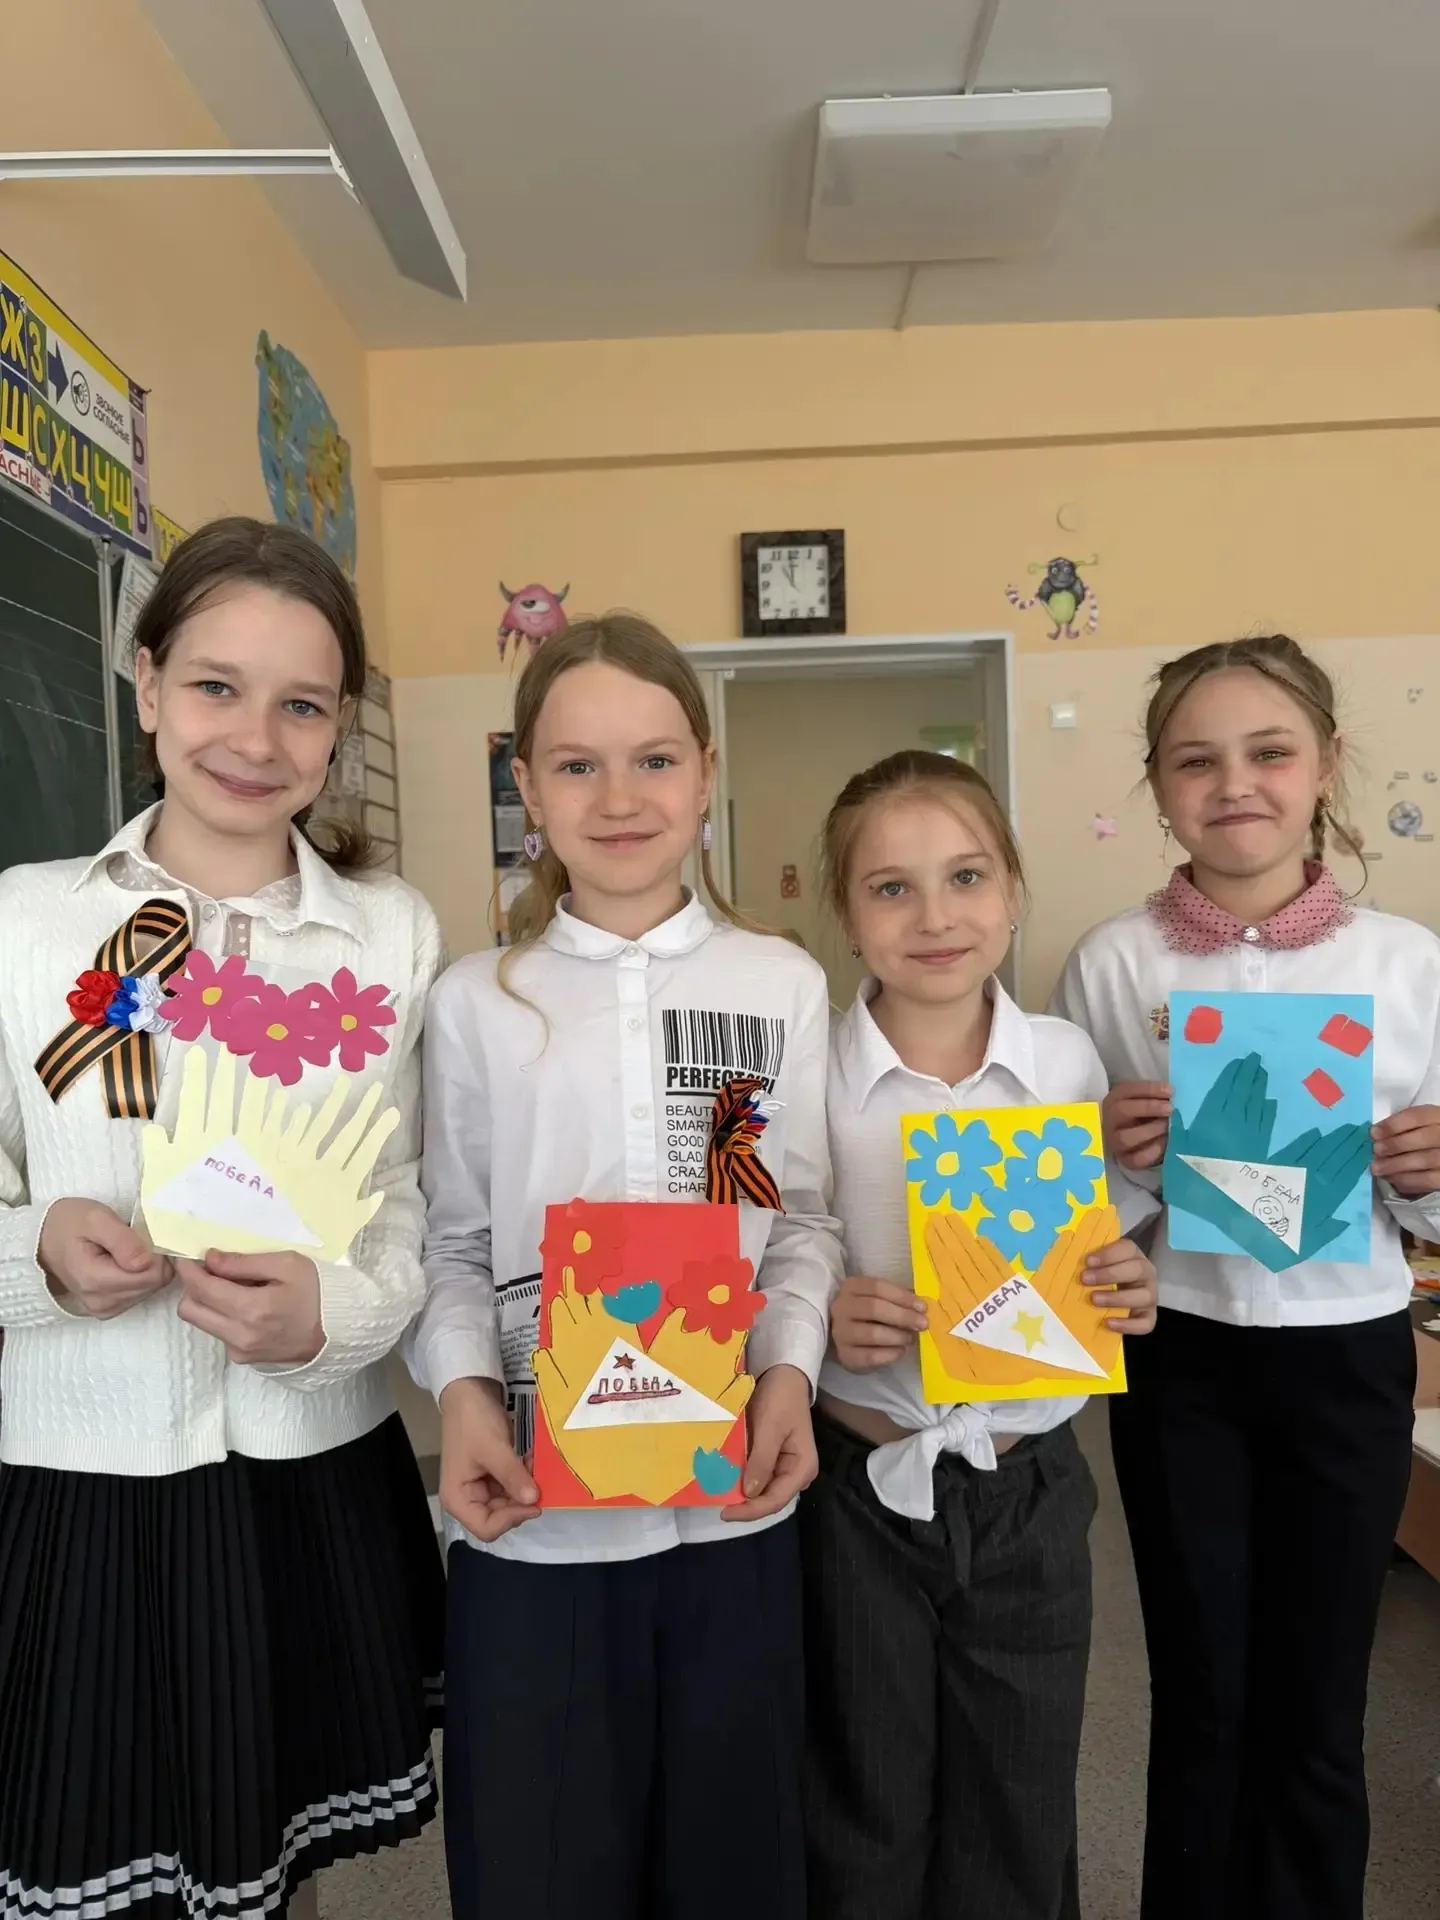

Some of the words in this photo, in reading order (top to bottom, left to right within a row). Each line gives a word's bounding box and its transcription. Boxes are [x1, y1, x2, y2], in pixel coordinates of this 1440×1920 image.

[1, 292, 27, 370] Ж
[29, 320, 44, 383] З
[2, 377, 29, 452] Ш
[33, 404, 48, 466] С
[52, 420, 68, 486] Х
[71, 435, 91, 500] Ц
[94, 452, 110, 514] Ч
[112, 466, 132, 530] Щ
[666, 1105, 714, 1117] BEAUT
[666, 1120, 712, 1132] SMART
[667, 1134, 704, 1147] GOOD
[668, 1150, 703, 1162] GLAD
[668, 1166, 705, 1178] CRAZ
[668, 1181, 707, 1193] CHAR
[964, 1279, 1027, 1333] ПОБЕДА
[598, 1376, 674, 1394] ПОБЕДА
